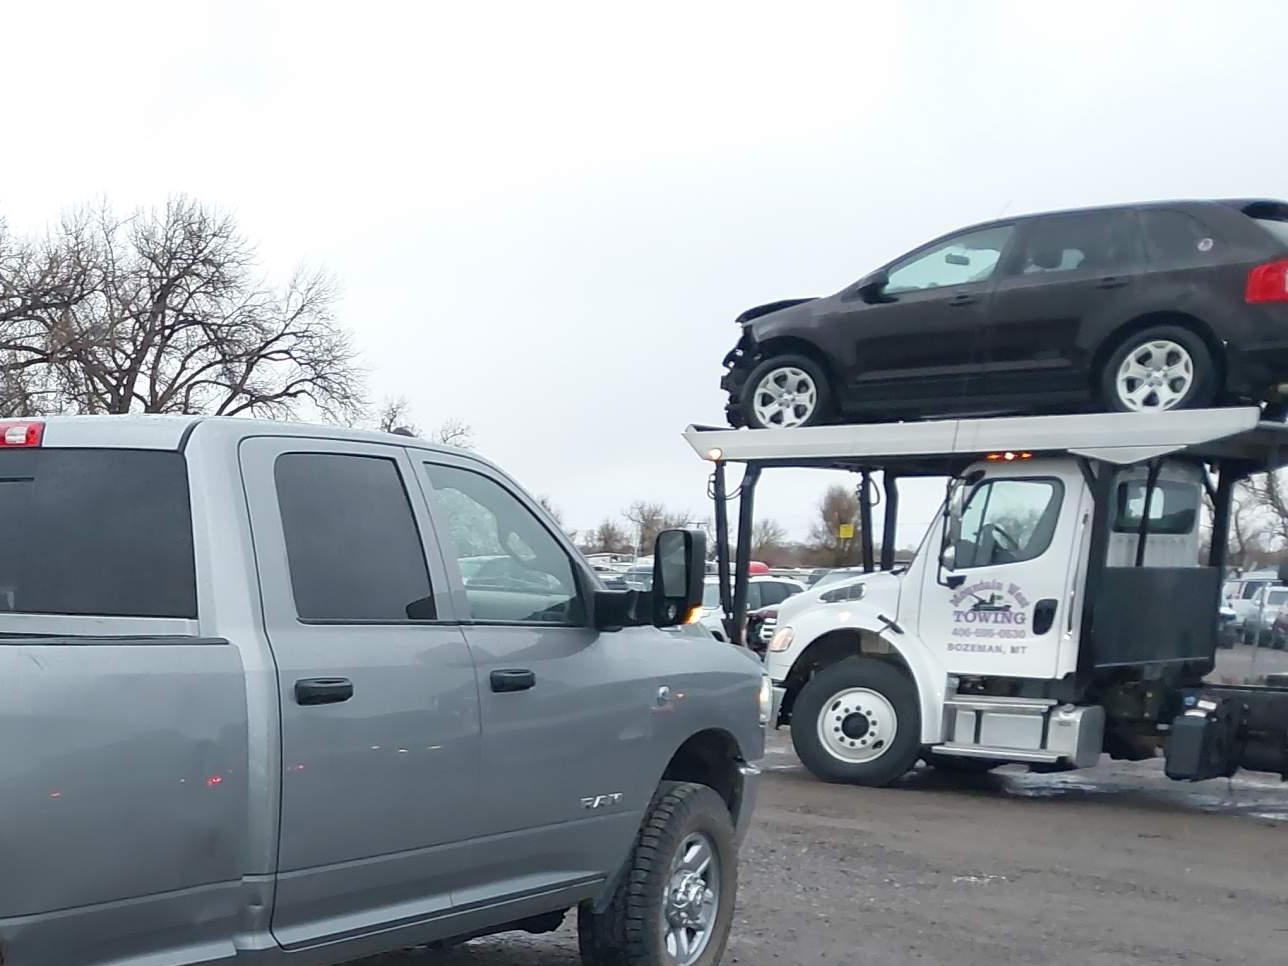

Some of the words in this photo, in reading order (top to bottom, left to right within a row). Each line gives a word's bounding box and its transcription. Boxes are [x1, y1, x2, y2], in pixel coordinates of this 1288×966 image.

[954, 610, 1026, 624] TOWING
[948, 643, 1006, 654] BOZEMAN,
[1010, 646, 1027, 654] MT
